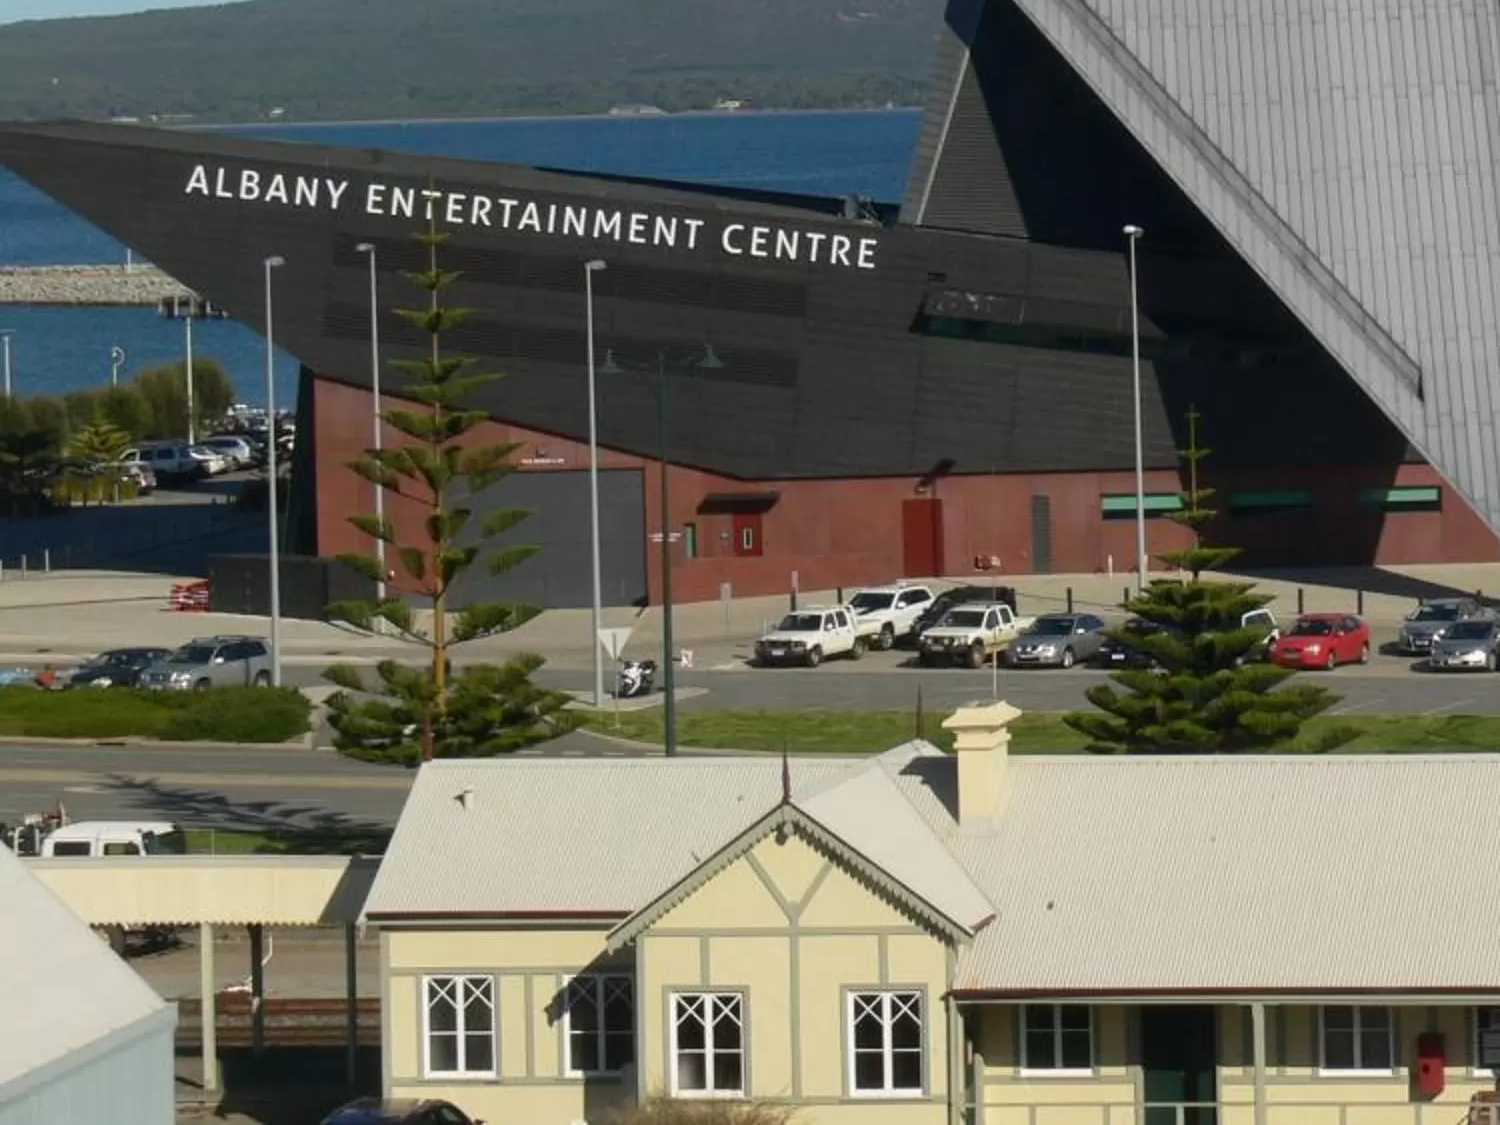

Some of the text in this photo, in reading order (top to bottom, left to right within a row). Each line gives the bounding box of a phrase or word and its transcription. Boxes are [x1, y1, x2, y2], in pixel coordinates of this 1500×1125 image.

[185, 165, 878, 268] ALBANY ENTERTAINMENT CENTRE
